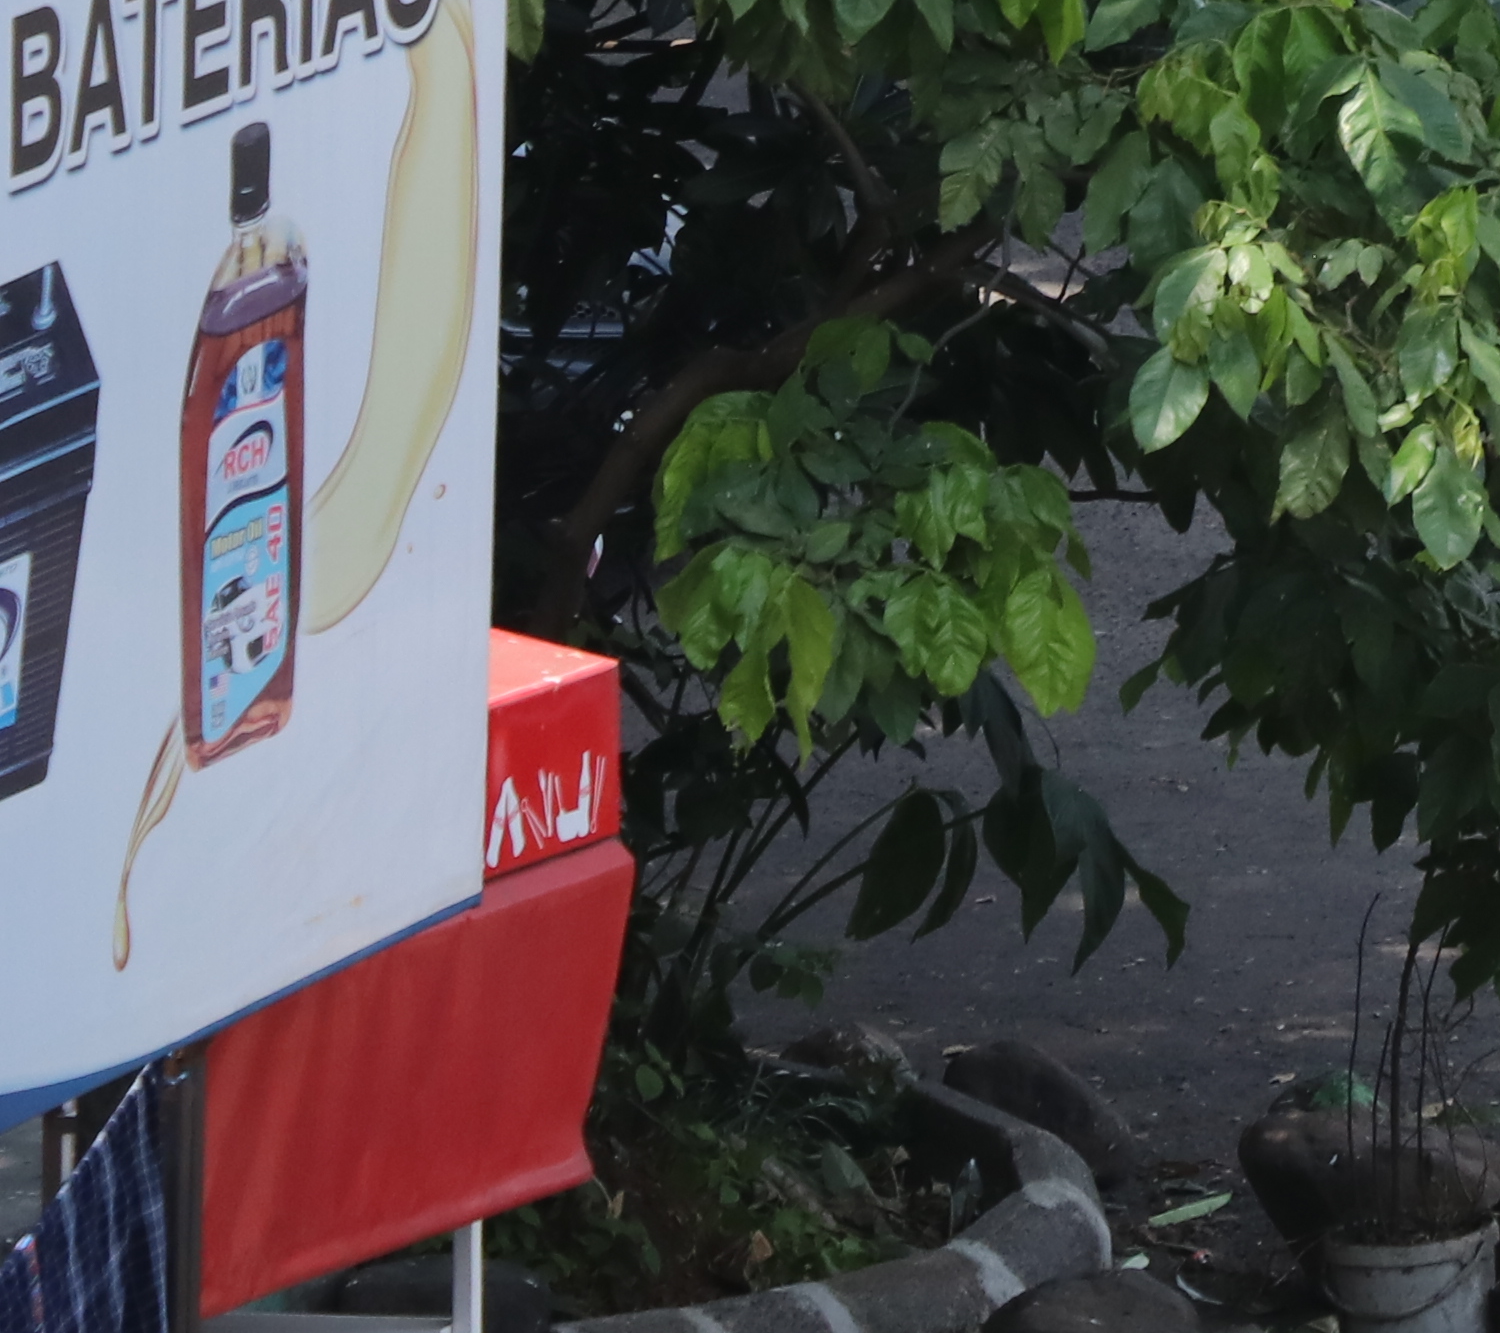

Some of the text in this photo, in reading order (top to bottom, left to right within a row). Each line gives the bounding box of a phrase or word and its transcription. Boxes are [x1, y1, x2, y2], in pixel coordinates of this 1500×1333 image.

[222, 436, 268, 481] RCH
[263, 502, 284, 653] SAE 40
